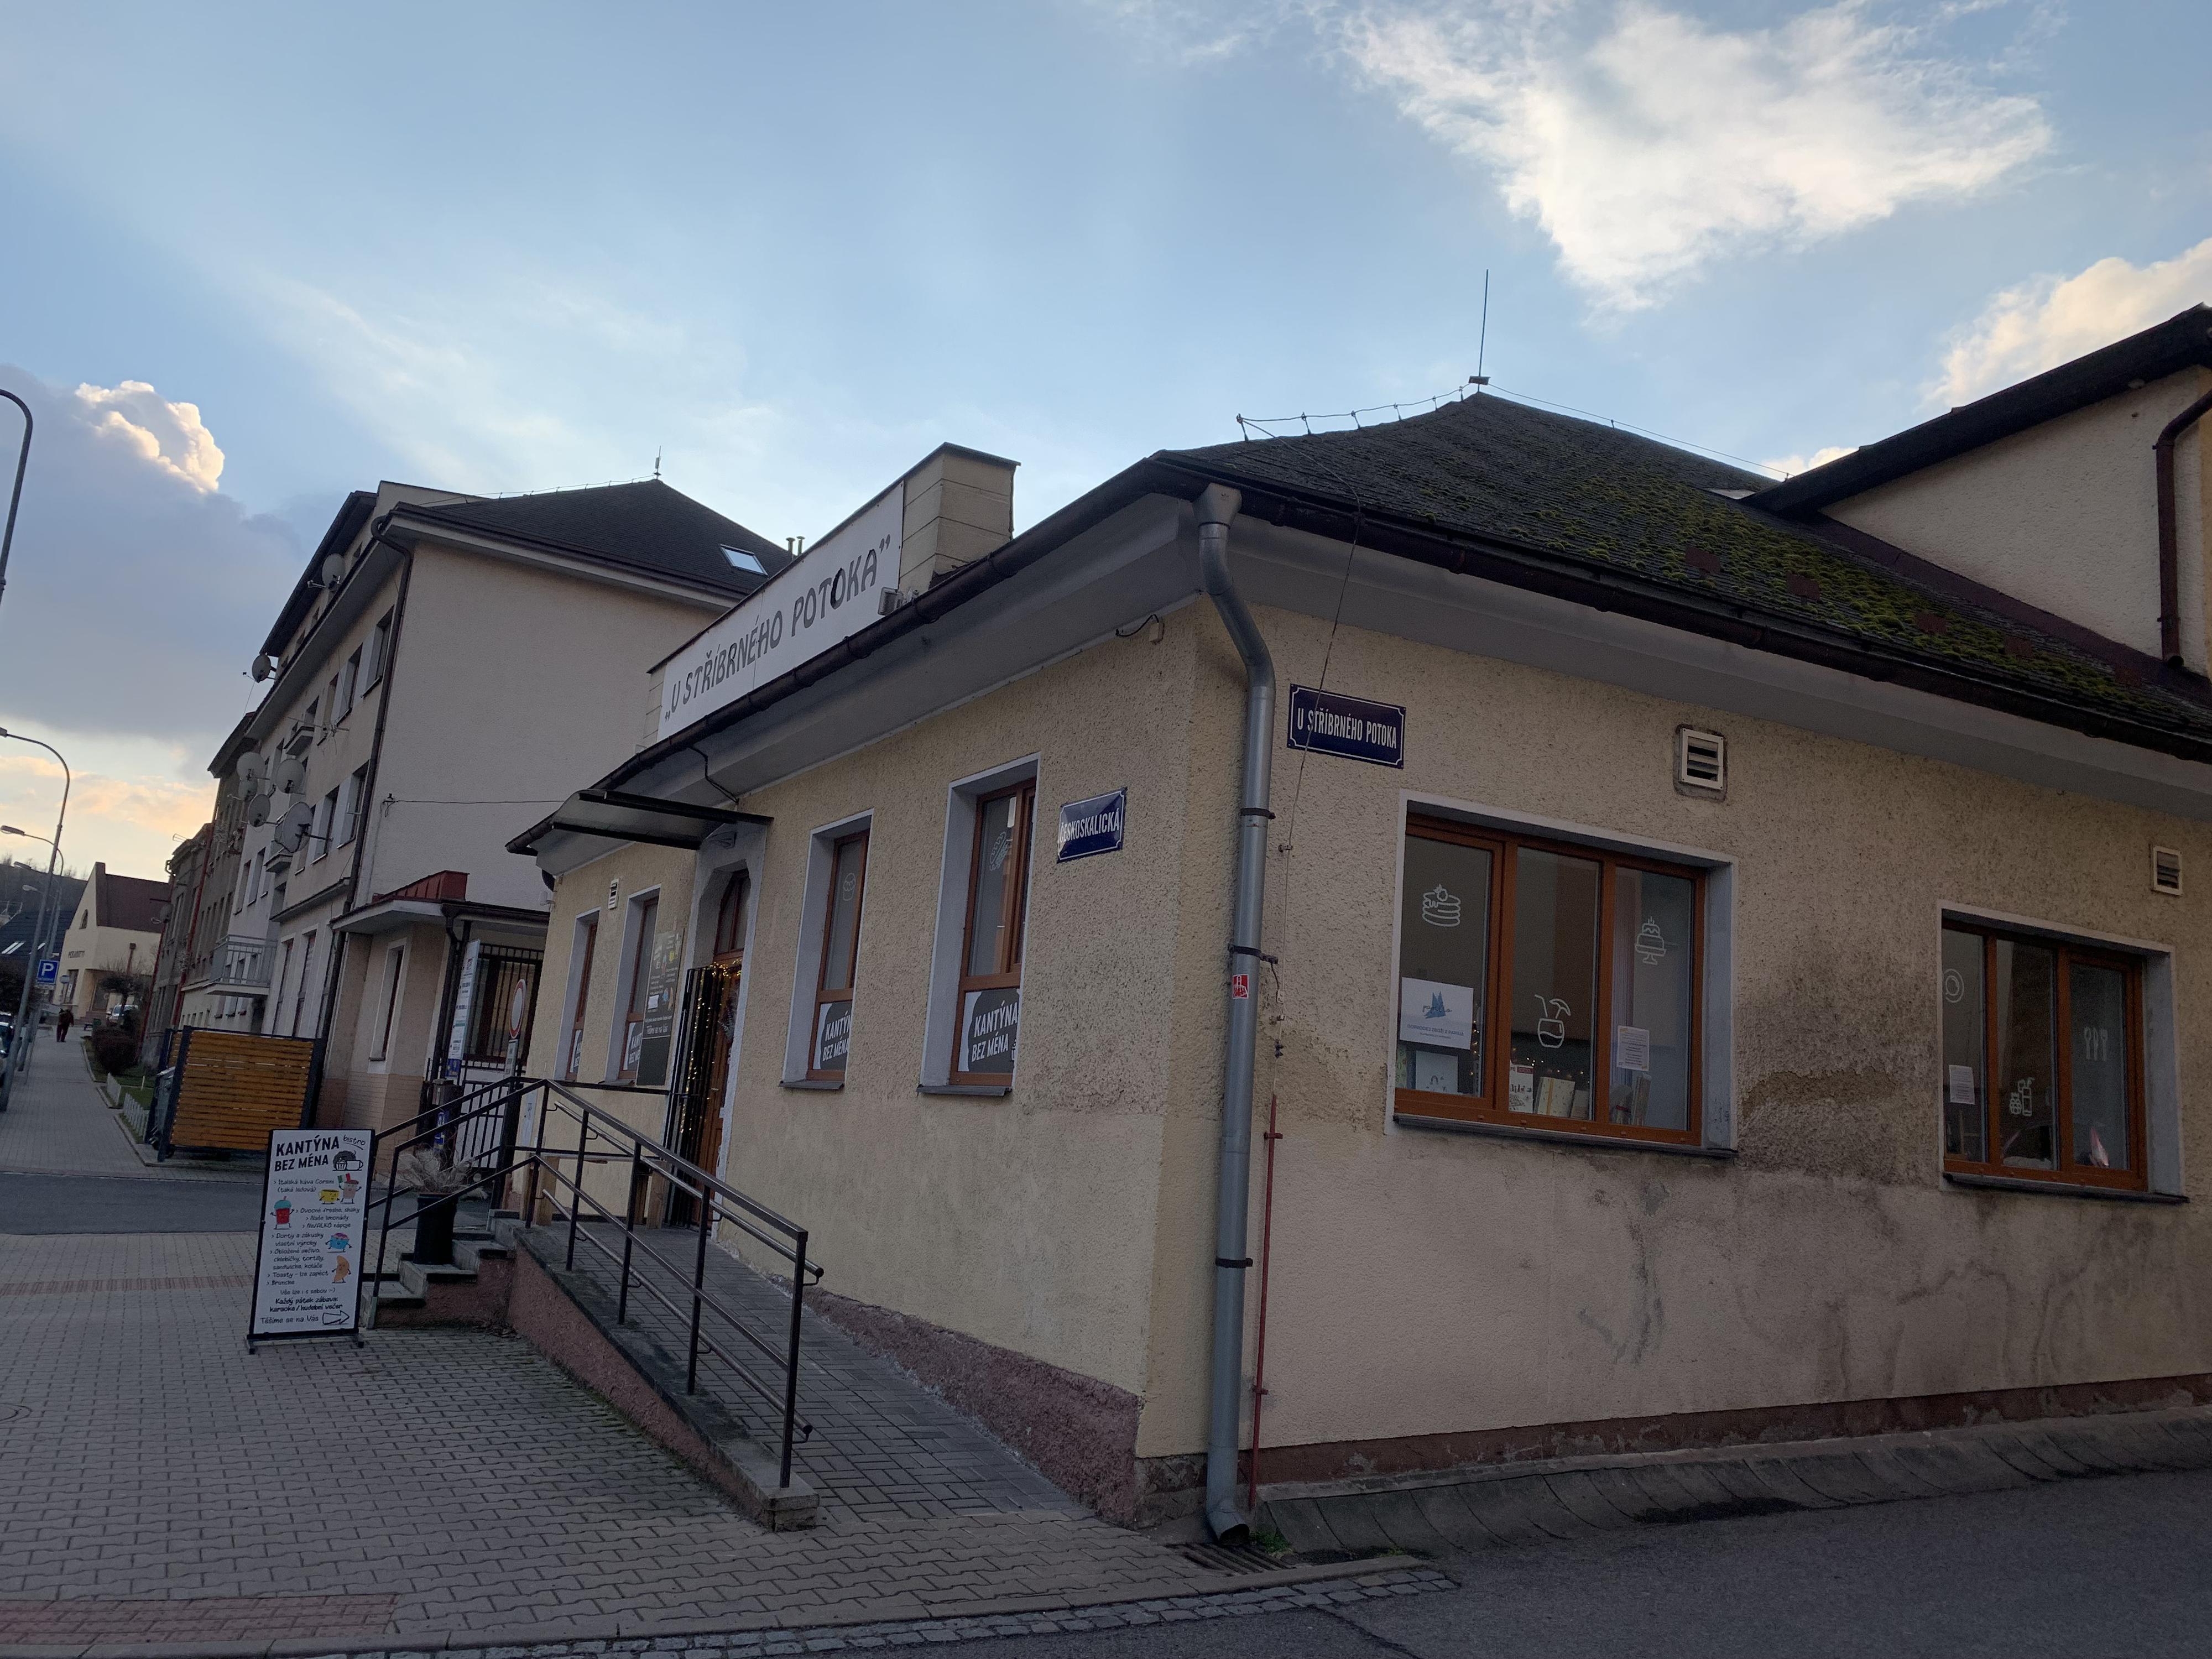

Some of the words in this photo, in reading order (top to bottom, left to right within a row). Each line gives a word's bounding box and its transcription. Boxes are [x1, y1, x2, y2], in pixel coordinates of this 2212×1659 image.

[683, 610, 783, 705] STŘÍBRNÉHO
[1297, 707, 1304, 730] U
[1307, 707, 1363, 741] STŘÍBRNÉHO
[1366, 721, 1397, 749] POTOKA
[1060, 807, 1120, 843] ČESKOSKALICKÁ
[41, 962, 54, 976] P
[974, 1000, 1018, 1037] KANTÝNA
[822, 1044, 834, 1062] BEZ
[833, 1036, 849, 1057] MÉNA
[971, 1041, 987, 1062] BEZ
[987, 1031, 1008, 1057] MÉNA
[276, 1135, 340, 1156] KANTÝNA
[343, 1135, 366, 1146] bistro
[274, 1159, 295, 1172] BEZ
[298, 1153, 328, 1168] MÉNA
